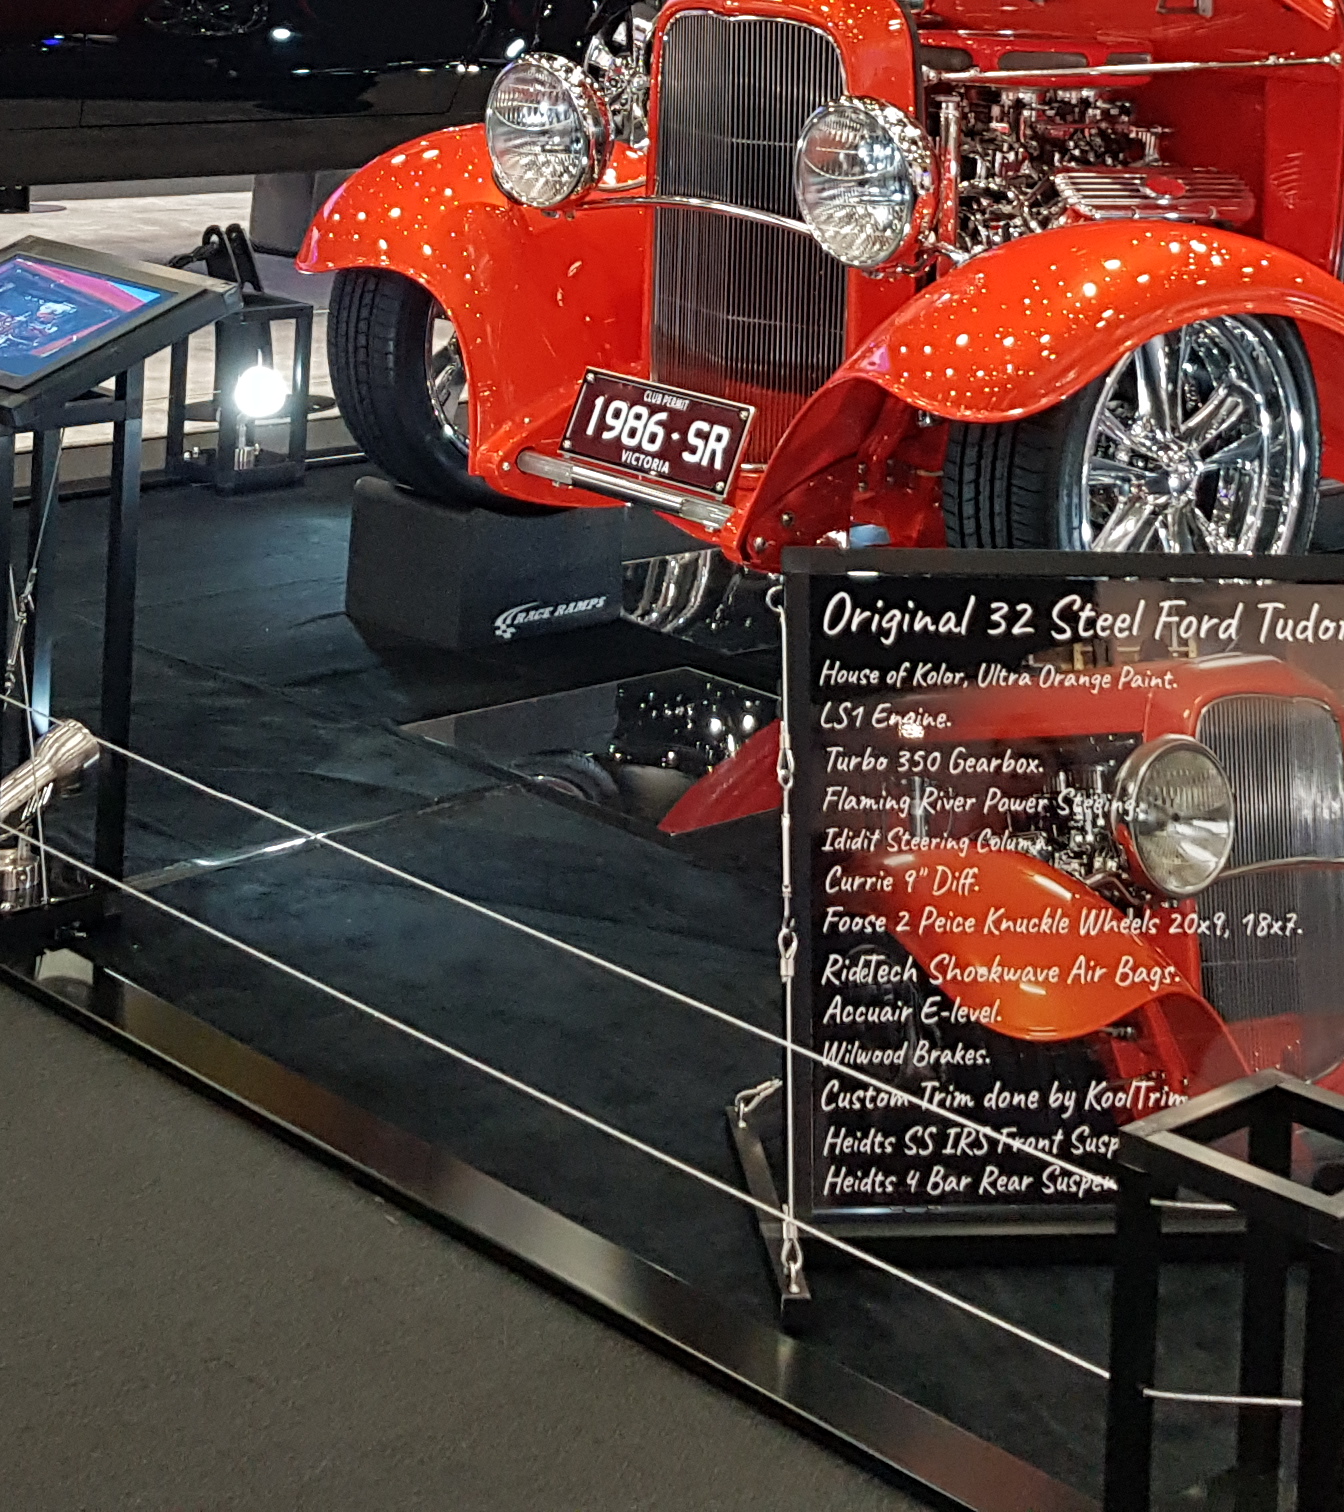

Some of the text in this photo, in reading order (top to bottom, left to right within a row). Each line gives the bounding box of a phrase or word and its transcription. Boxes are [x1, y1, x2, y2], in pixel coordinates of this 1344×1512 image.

[644, 390, 690, 411] CLUB PERMIT
[620, 449, 670, 474] VICTORIA
[513, 595, 607, 625] RACE RAMPS
[822, 591, 976, 646] Original
[986, 602, 1035, 635] 32
[1050, 594, 1146, 640] Steel
[1154, 599, 1244, 640] Ford
[819, 659, 1179, 694] House of Kolor, Ultra Orange Paint.
[820, 701, 952, 733] LS1 Engine.
[826, 746, 1045, 774] Turbo 350 Gearbox.
[822, 786, 911, 817] Flaming
[918, 786, 976, 814] River
[983, 787, 1049, 815] Power
[821, 826, 1053, 858] Ididit Steering Column.
[825, 865, 980, 896] Currie 9" Diff.
[823, 906, 1304, 939] Foose 2 Peice Knuckle Wheels 20x9, 18x7.
[821, 953, 918, 986] RideTech
[1067, 954, 1107, 985] Air
[1115, 954, 1182, 992] Bags.
[823, 994, 1003, 1024] Accuair E-level.
[823, 1040, 992, 1067] Wilwood Brakes.
[821, 1079, 909, 1111] Custom
[920, 1080, 975, 1111] Trim
[983, 1080, 1040, 1110] done
[1048, 1080, 1077, 1119] by
[823, 1125, 897, 1158] Heidts
[904, 1125, 937, 1157] SS
[942, 1126, 993, 1157] IRS
[997, 1126, 1065, 1155] Front
[823, 1165, 897, 1196] Heidts
[906, 1169, 921, 1194] 4
[926, 1165, 973, 1195] Bar
[979, 1165, 1034, 1196] Rear
